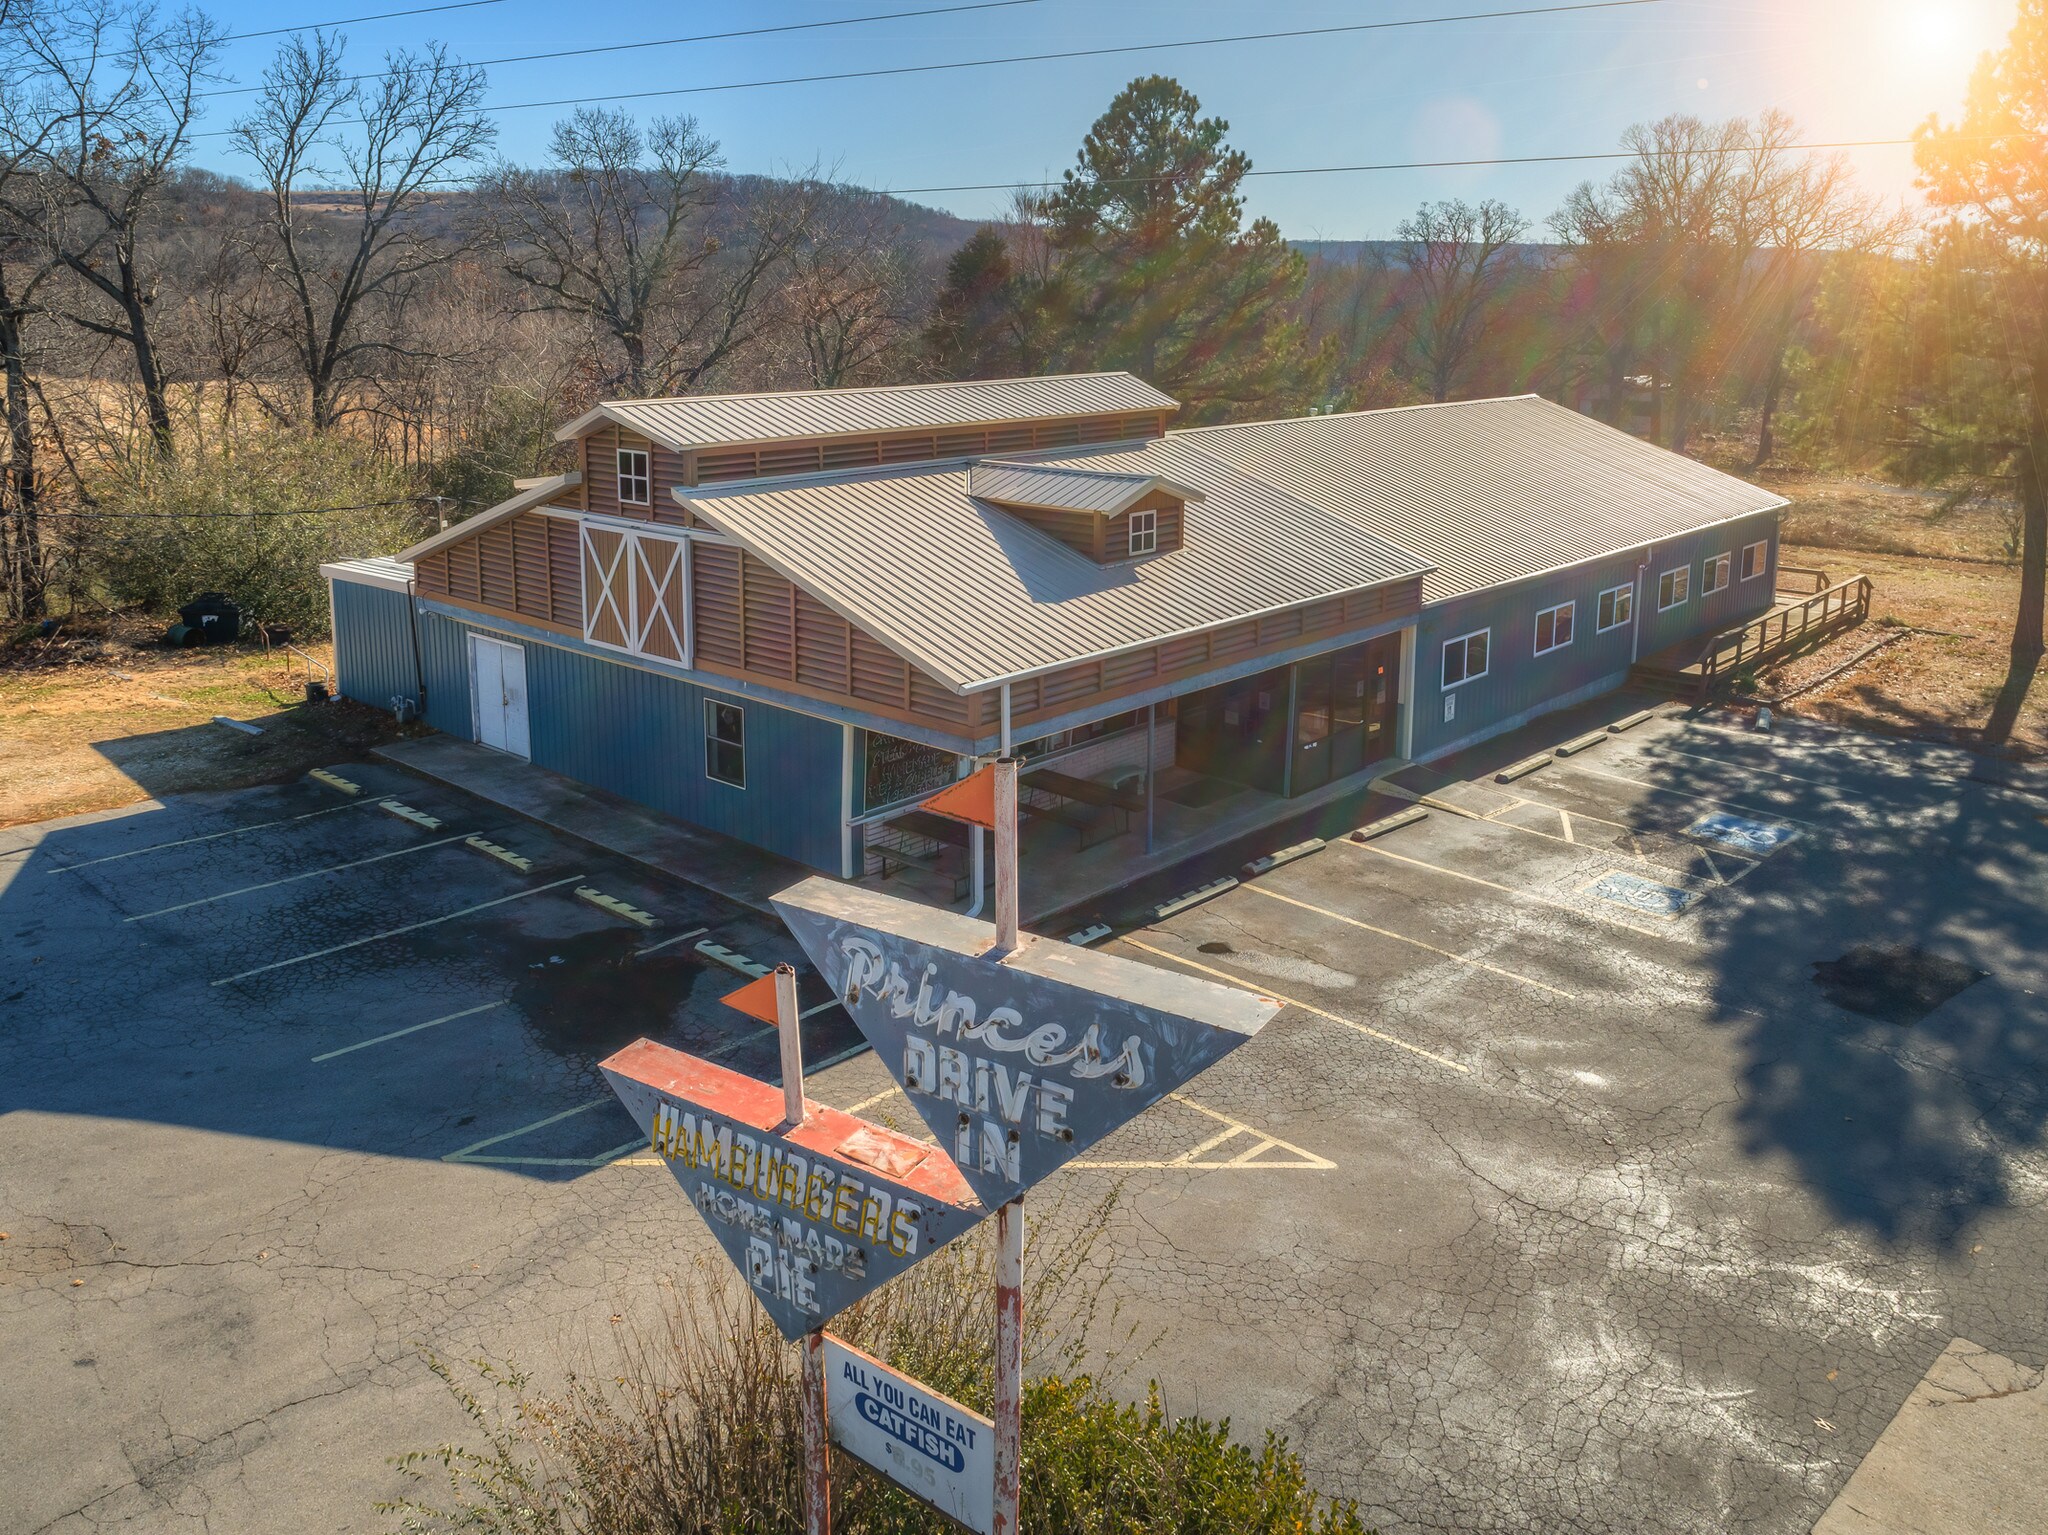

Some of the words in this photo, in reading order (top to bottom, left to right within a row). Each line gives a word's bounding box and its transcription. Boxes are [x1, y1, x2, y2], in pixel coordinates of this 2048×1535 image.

[840, 935, 1147, 1090] Princess
[902, 1033, 1075, 1143] DRIVE
[652, 1102, 919, 1258] HAMBURGERS
[954, 1112, 1021, 1185] IN
[694, 1181, 774, 1239] HOME
[776, 1216, 867, 1282] MADE
[745, 1236, 821, 1316] PIE
[843, 1361, 869, 1391] ALL
[873, 1375, 905, 1410] YOU
[909, 1396, 941, 1431] CAN
[945, 1415, 976, 1450] EAT
[863, 1397, 956, 1468] CATFISH
